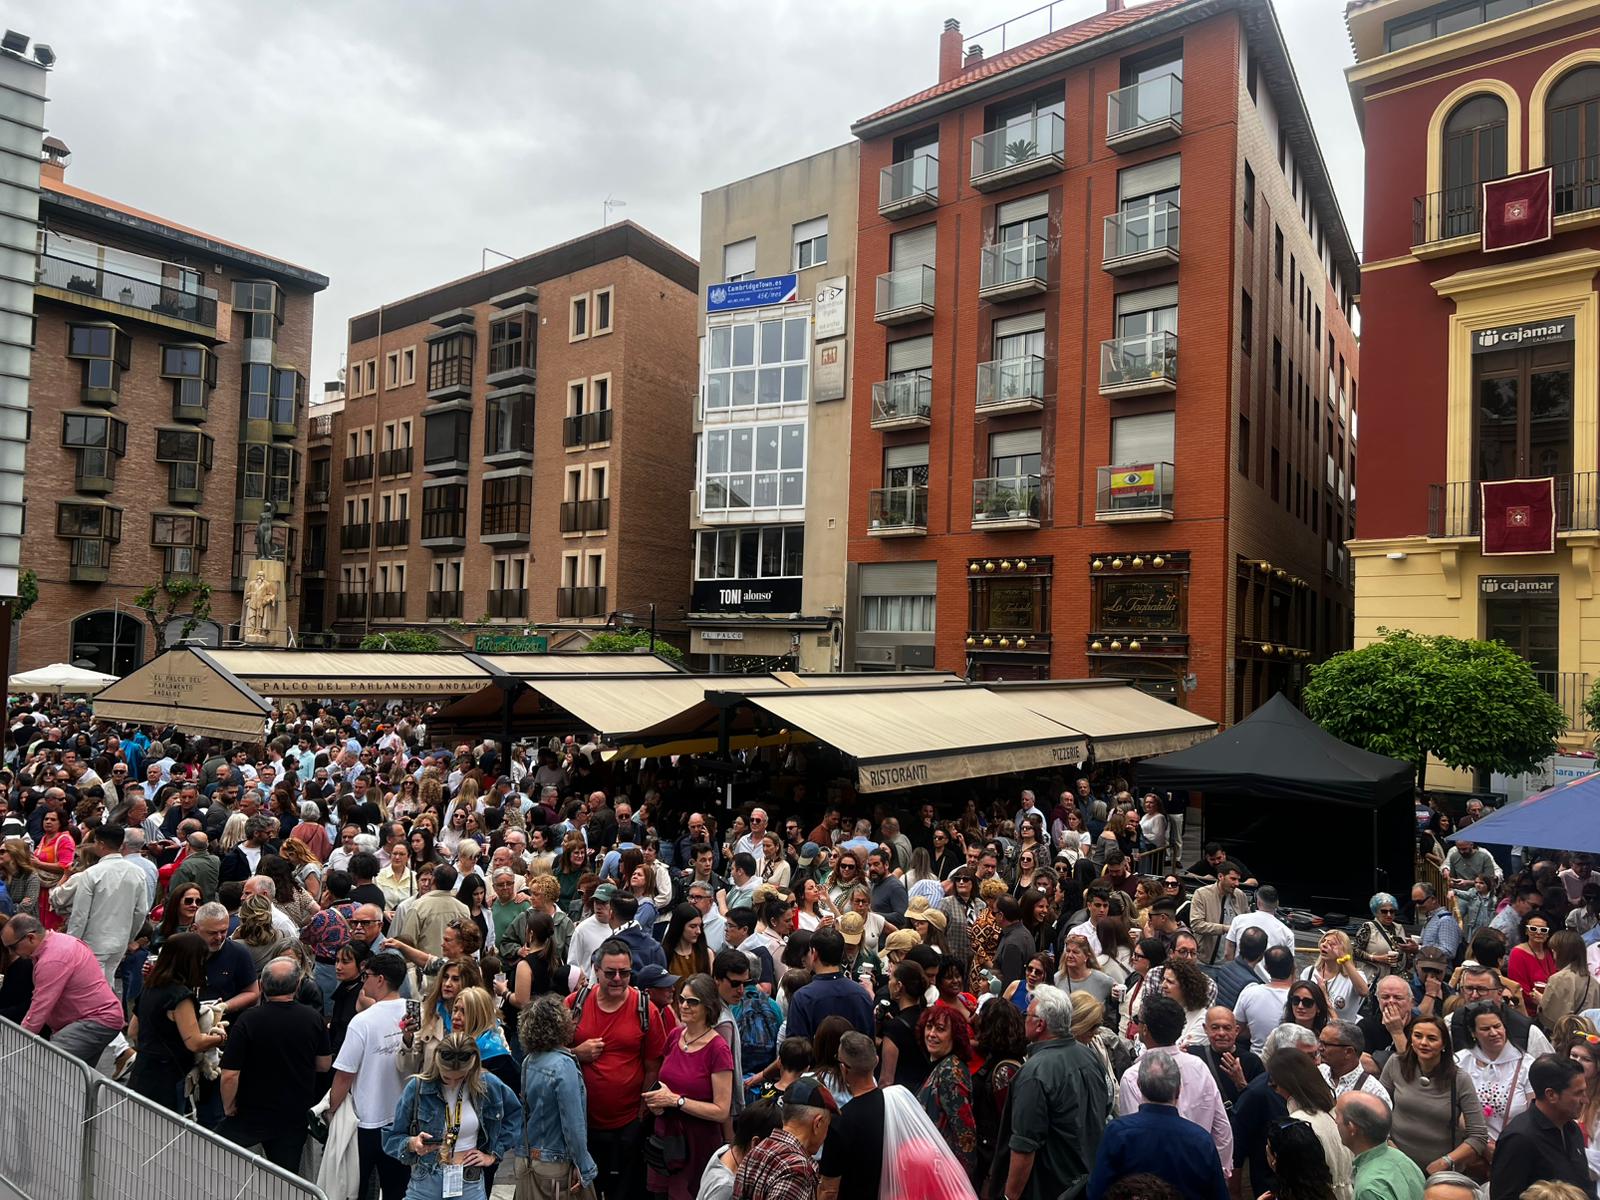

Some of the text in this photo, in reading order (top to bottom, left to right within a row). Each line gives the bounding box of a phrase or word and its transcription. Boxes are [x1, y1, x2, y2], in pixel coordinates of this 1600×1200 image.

[728, 280, 782, 292] CambridgeTown.es
[1501, 324, 1565, 342] cajamar
[1500, 580, 1554, 592] cajamar
[719, 589, 772, 605] TONI alonso
[438, 682, 488, 690] ANDALUZ
[1052, 745, 1080, 761] PIZZERIE
[869, 764, 928, 786] RISTORANTI
